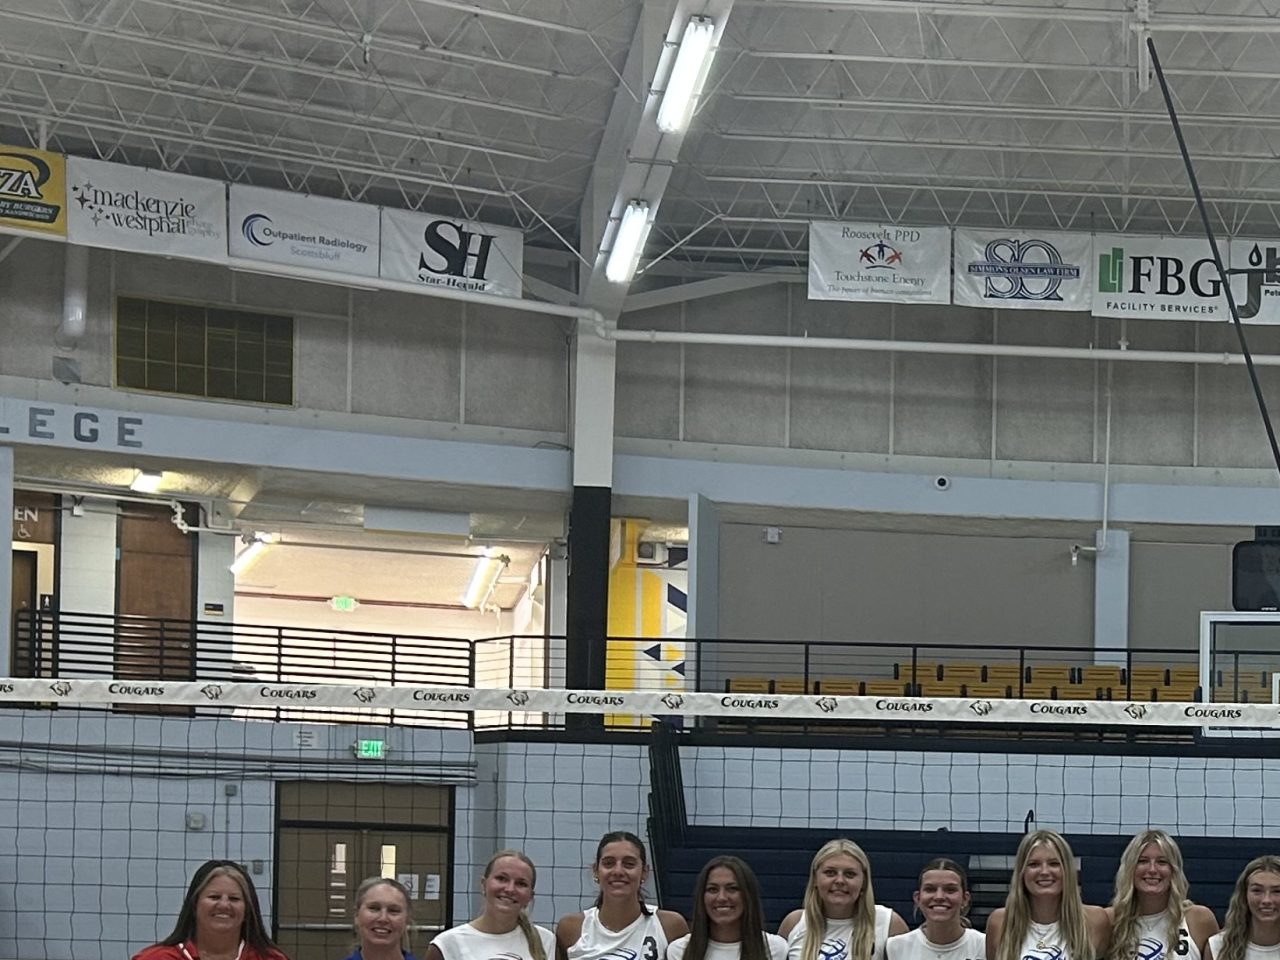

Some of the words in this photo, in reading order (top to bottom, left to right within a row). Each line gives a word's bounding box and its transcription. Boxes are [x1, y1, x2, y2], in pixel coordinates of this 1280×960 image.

[93, 189, 196, 218] mackenzie
[112, 212, 187, 236] westphal
[263, 227, 316, 245] Outpatient
[319, 235, 368, 253] Radiology
[841, 226, 891, 240] Roosevelt
[894, 230, 920, 242] PPD
[291, 246, 341, 261] Scottsbluff
[418, 220, 497, 281] SH
[970, 265, 1008, 274] SIMMONS
[1037, 267, 1056, 275] LAW
[1056, 268, 1077, 276] FIRM
[984, 239, 1063, 300] SO
[1128, 256, 1223, 298] FBG
[417, 273, 486, 292] Star-Herald
[834, 270, 889, 283] Touchstone
[892, 273, 926, 286] Energy
[1106, 301, 1155, 312] FACILITY
[1161, 303, 1215, 314] SERVICES
[108, 682, 165, 696] COUGARS
[260, 686, 317, 700] COUGARS
[413, 689, 470, 703] COUGARS
[567, 692, 625, 706] COUGARS
[721, 696, 779, 710] COUGARS
[875, 699, 934, 713] COUGARS
[1030, 702, 1088, 716] COUGARS
[1184, 705, 1242, 719] COUGARS
[361, 741, 382, 757] EXIT
[1175, 928, 1189, 956] 6
